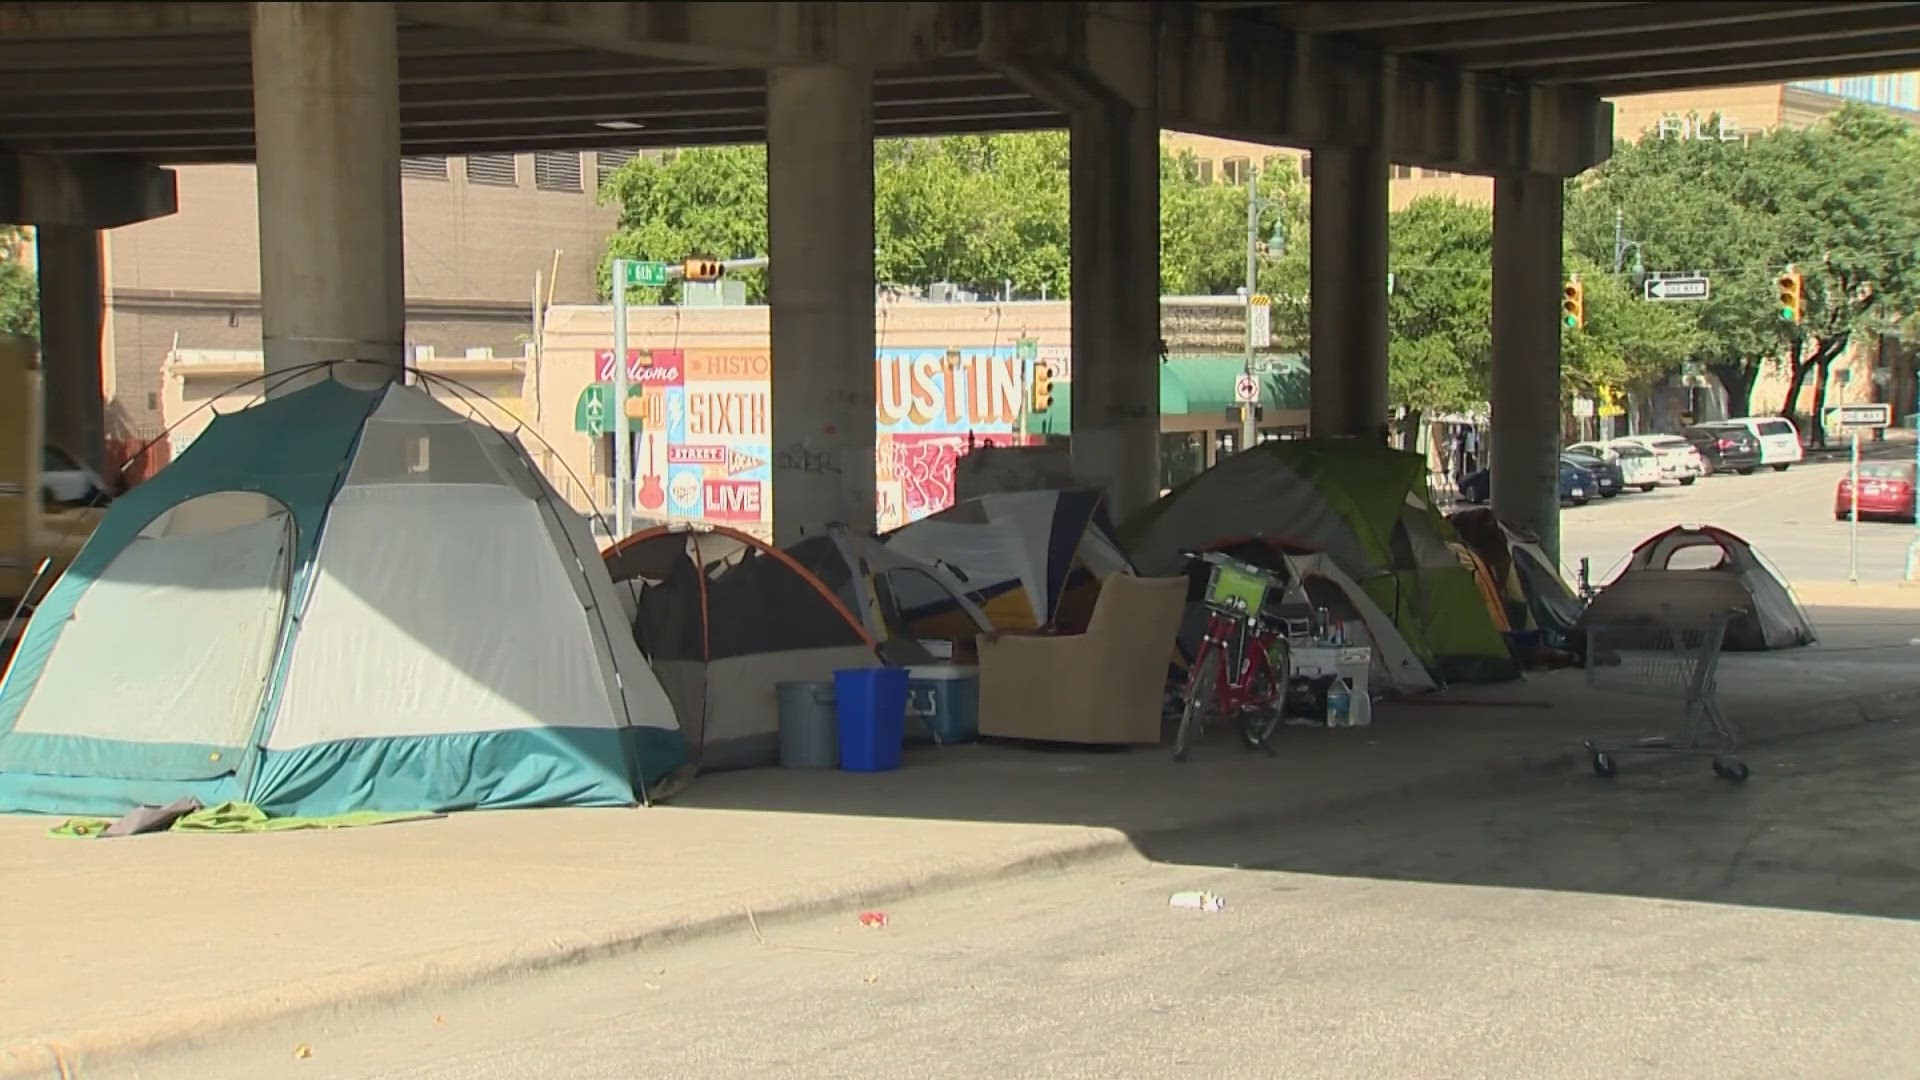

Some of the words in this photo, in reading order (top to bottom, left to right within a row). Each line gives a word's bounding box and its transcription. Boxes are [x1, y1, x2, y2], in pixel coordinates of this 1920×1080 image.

[635, 264, 652, 281] 6th
[601, 351, 679, 381] Wlcome
[706, 356, 769, 375] HISTO
[689, 392, 766, 435] SIXTH
[706, 485, 760, 512] LIVE
